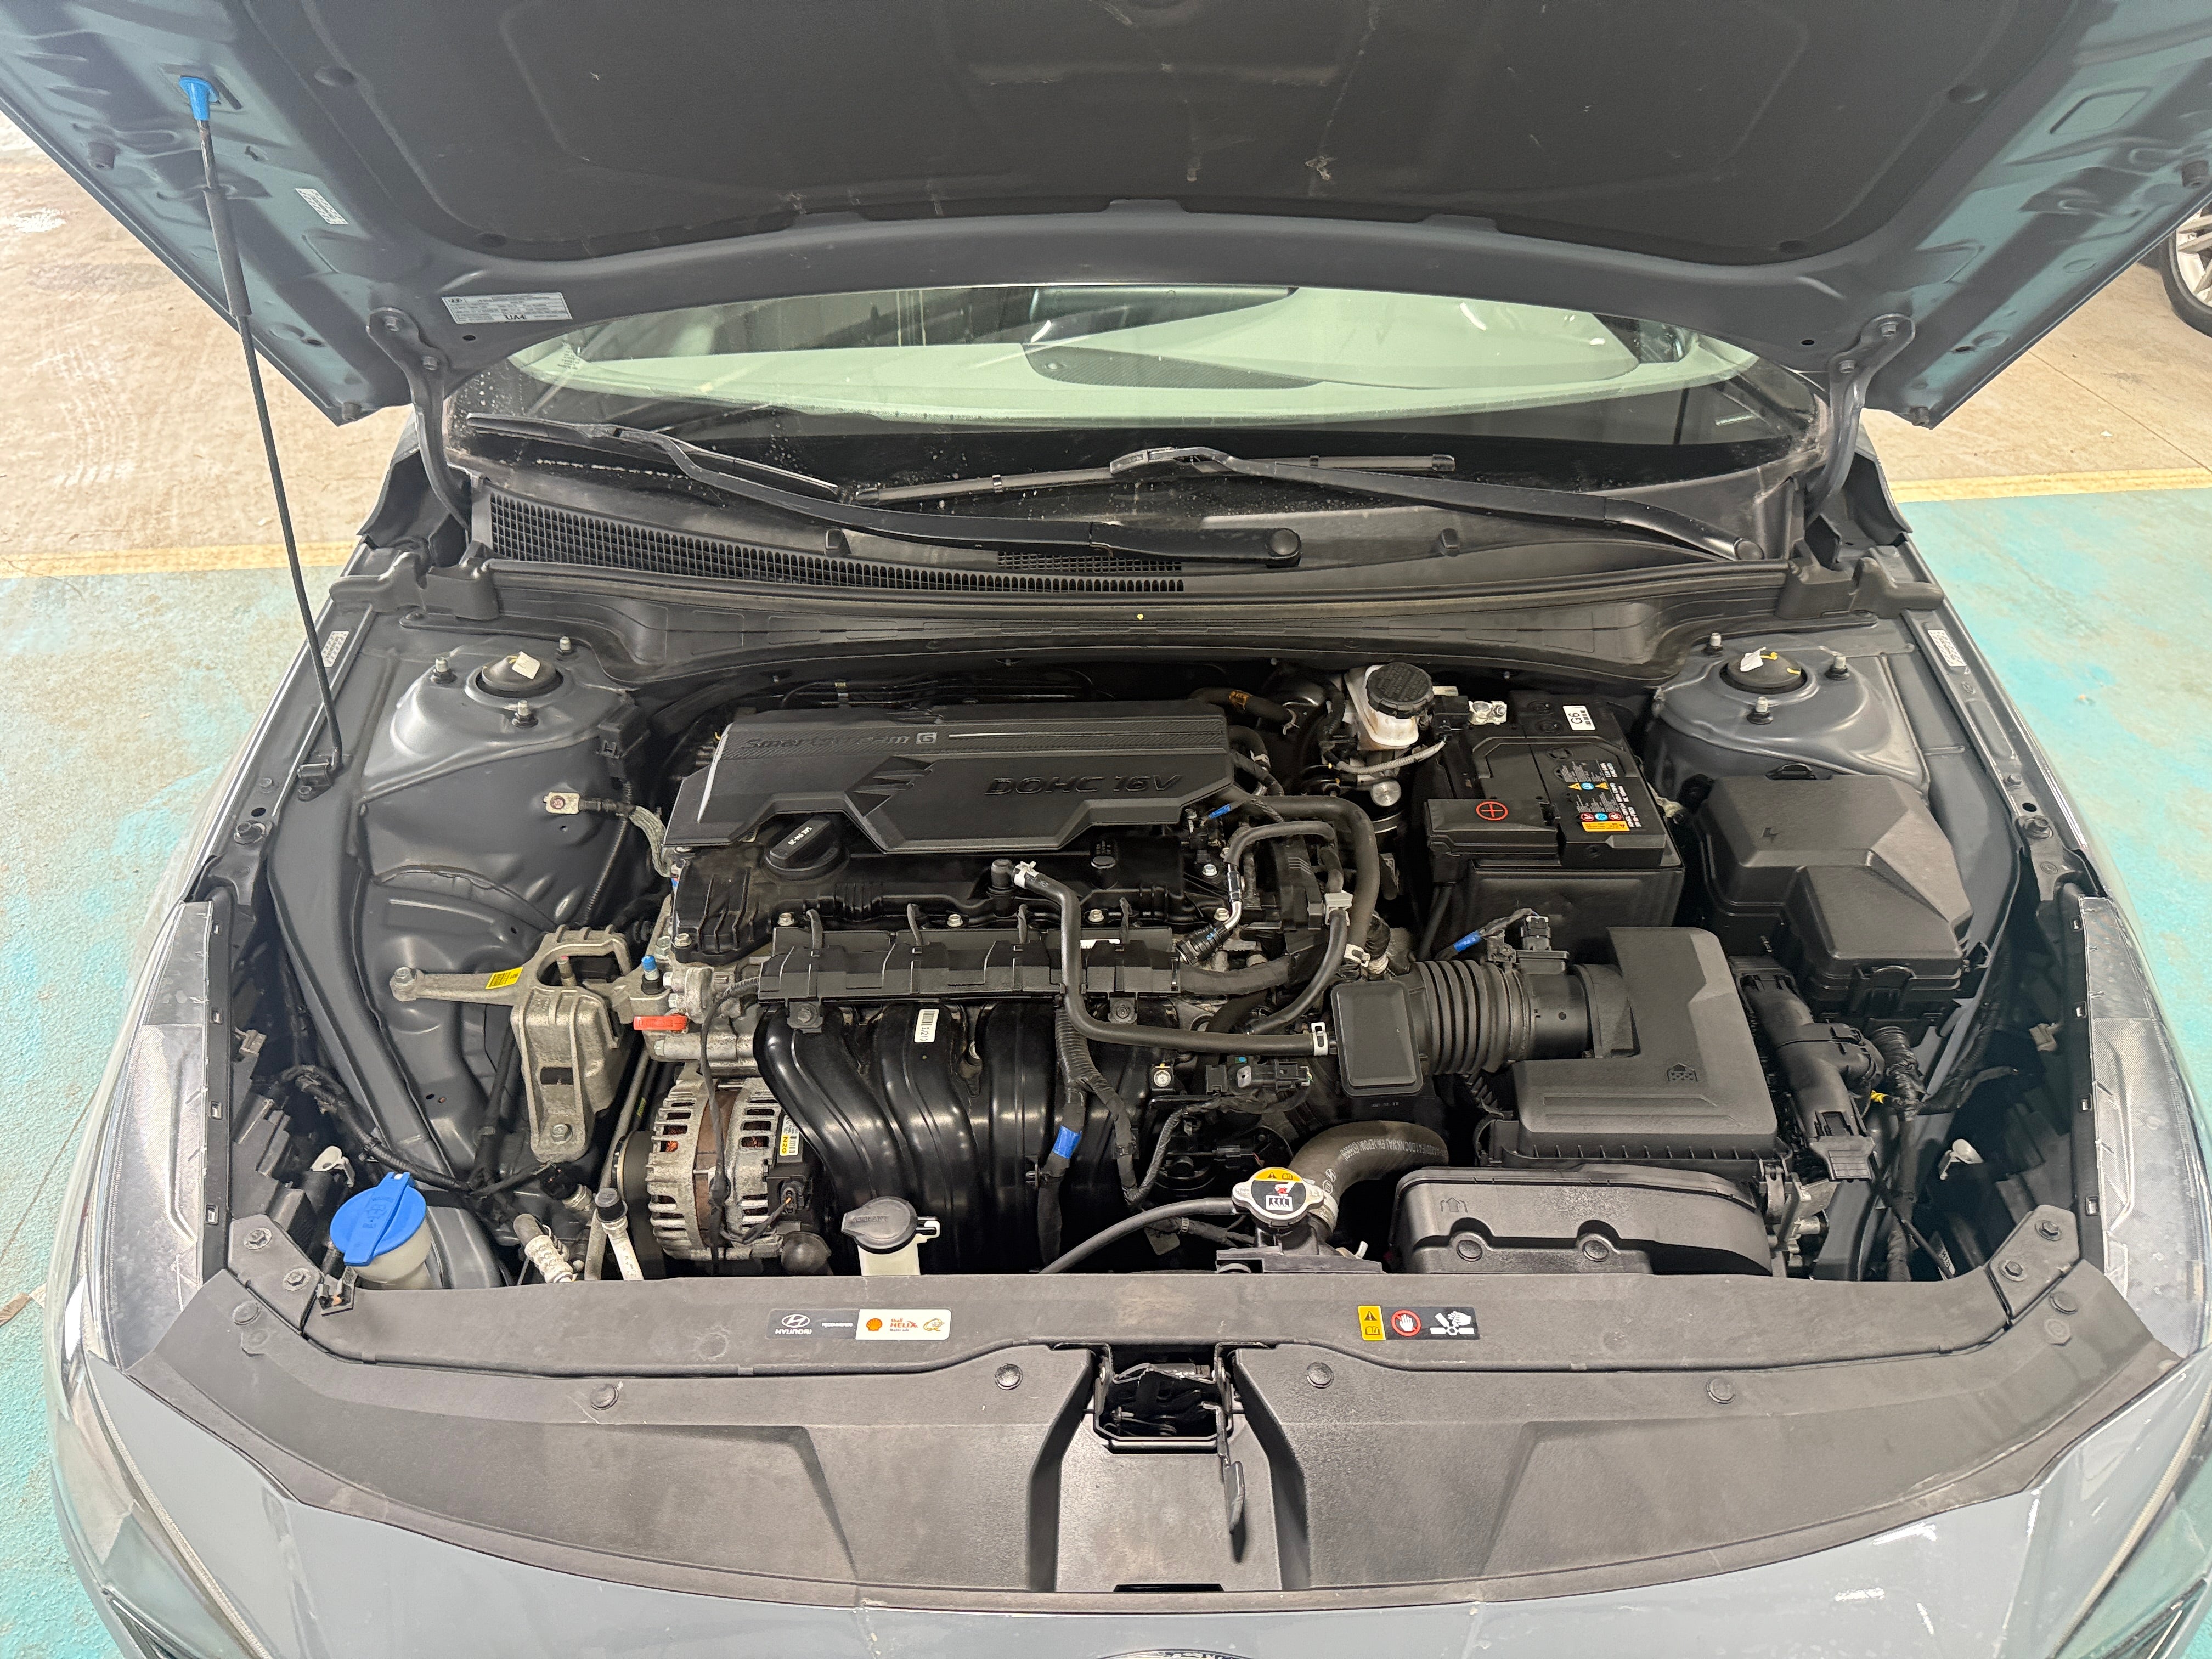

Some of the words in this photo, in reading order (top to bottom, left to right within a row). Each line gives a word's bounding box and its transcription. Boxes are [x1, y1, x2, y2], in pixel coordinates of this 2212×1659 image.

[1570, 712, 1583, 725] G6
[984, 775, 1105, 795] DOHC
[1113, 774, 1182, 791] 16V
[801, 826, 812, 835] SAE
